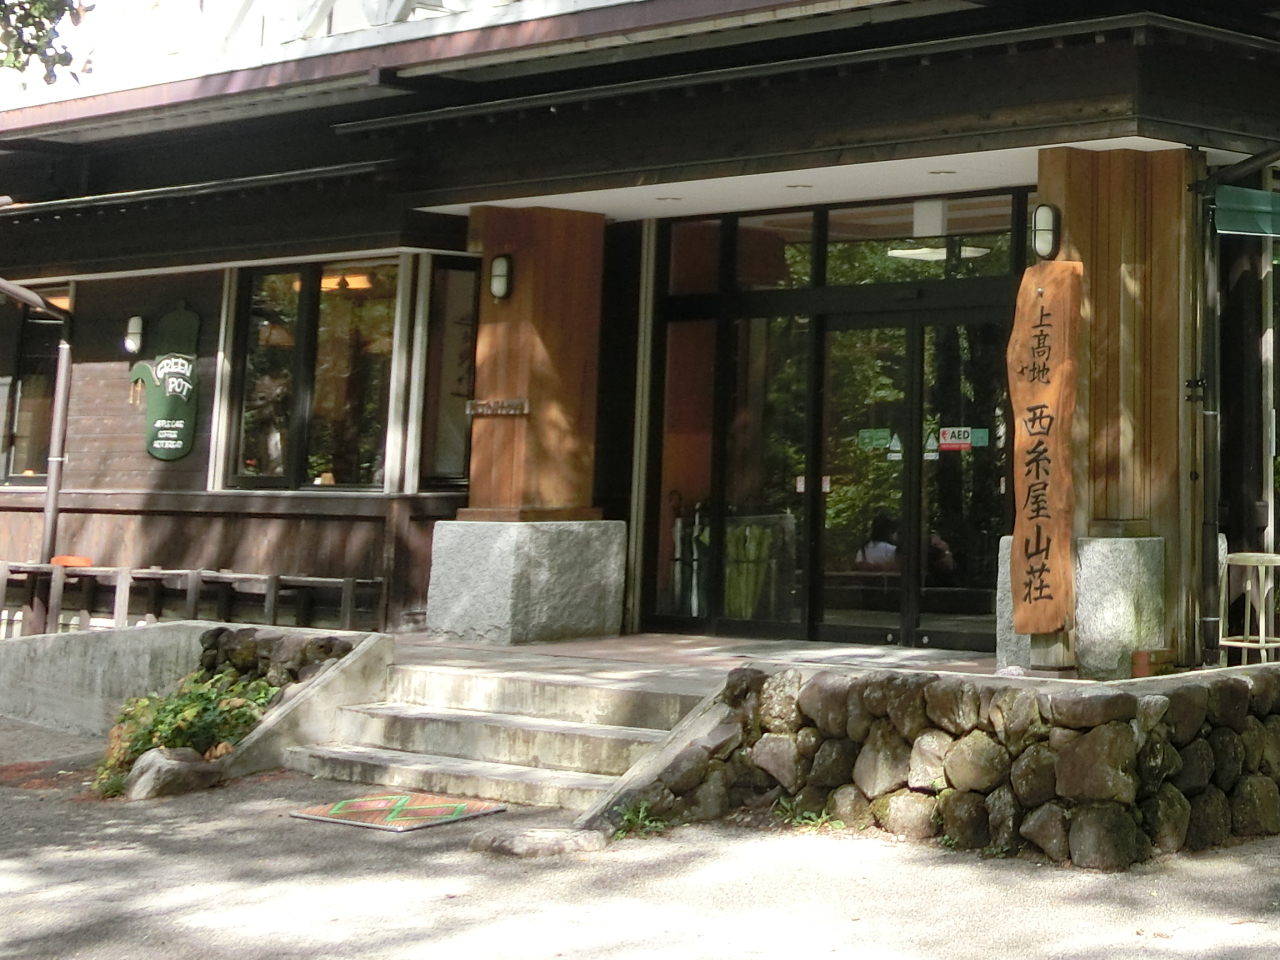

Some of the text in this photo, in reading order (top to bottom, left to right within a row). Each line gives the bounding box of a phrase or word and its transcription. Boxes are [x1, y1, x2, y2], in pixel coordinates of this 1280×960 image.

[157, 358, 192, 378] GREEN
[168, 377, 192, 395] POT
[949, 430, 970, 440] AED
[1023, 404, 1054, 604] 西糸屋山荘
